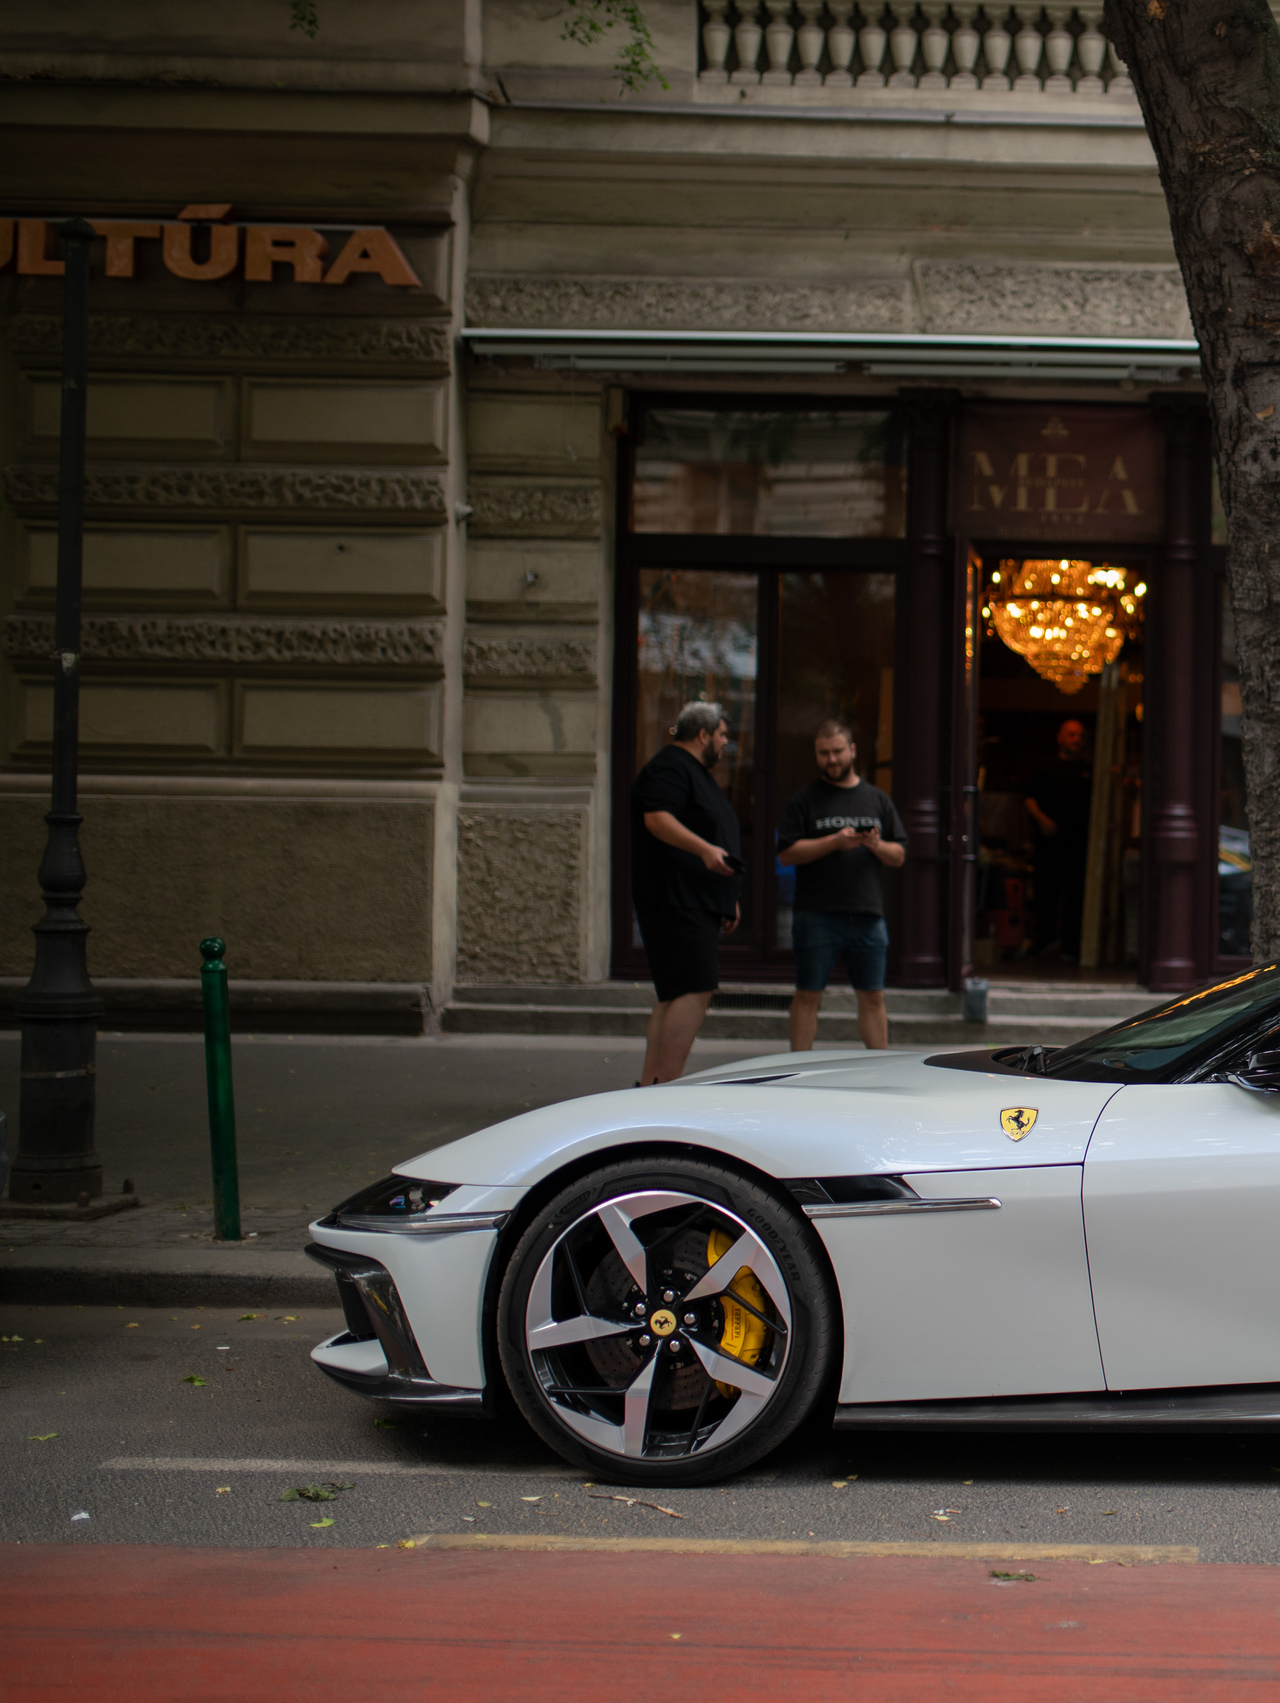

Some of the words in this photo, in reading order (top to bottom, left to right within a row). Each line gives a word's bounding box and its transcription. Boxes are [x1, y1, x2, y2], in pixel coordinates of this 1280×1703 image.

[0, 203, 422, 287] LTÚRA
[967, 451, 1145, 515] MEA
[746, 1208, 800, 1281] GOODYEAR
[734, 1307, 742, 1339] Ferrari
